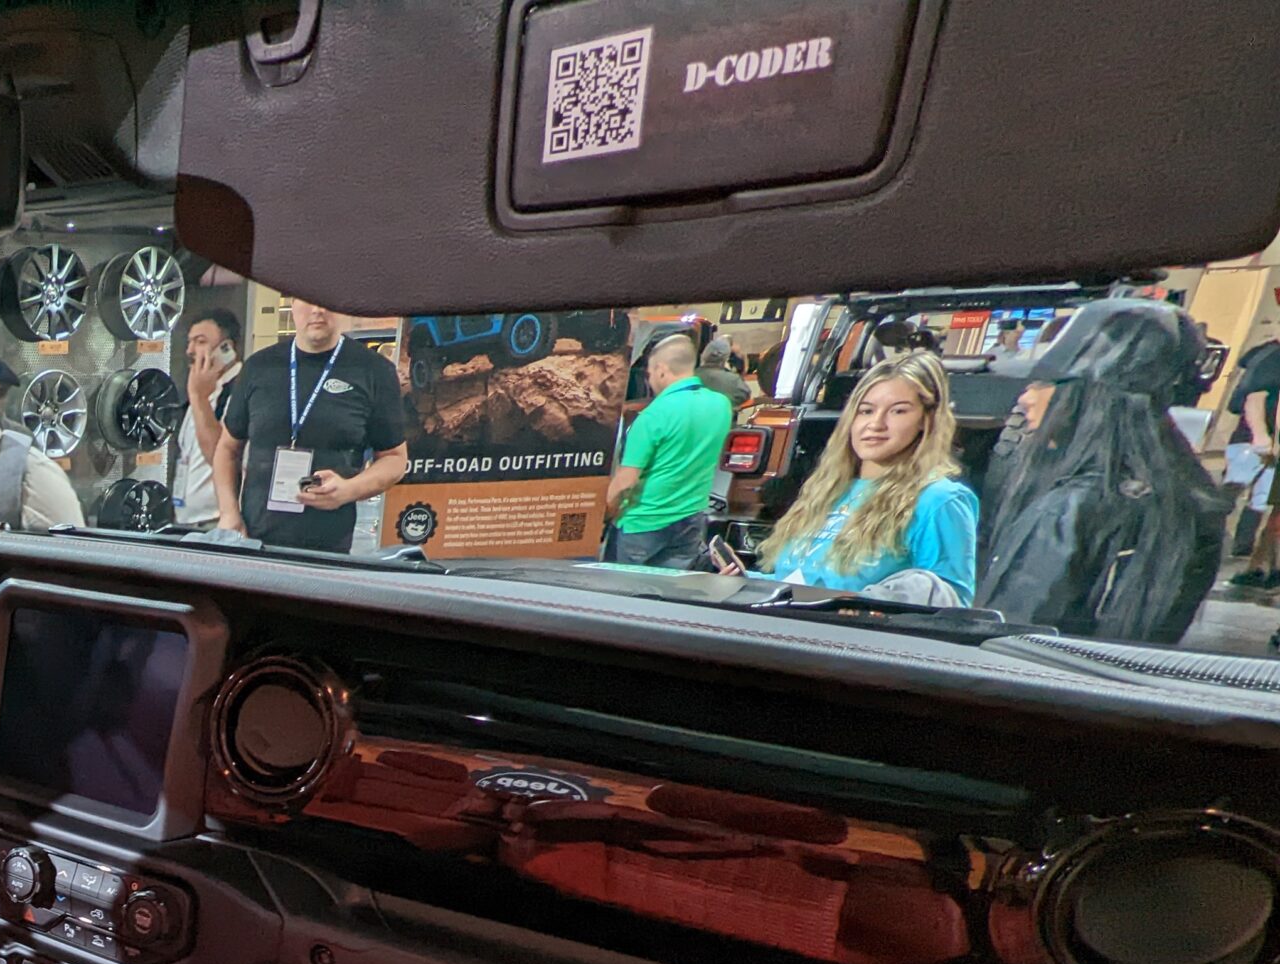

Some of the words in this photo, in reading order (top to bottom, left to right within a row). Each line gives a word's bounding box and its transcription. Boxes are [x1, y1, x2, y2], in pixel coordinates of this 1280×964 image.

[683, 37, 832, 92] D-CODER
[404, 457, 493, 474] OFF-ROAD
[499, 451, 605, 471] OUTFITTING
[407, 512, 428, 521] Jeep
